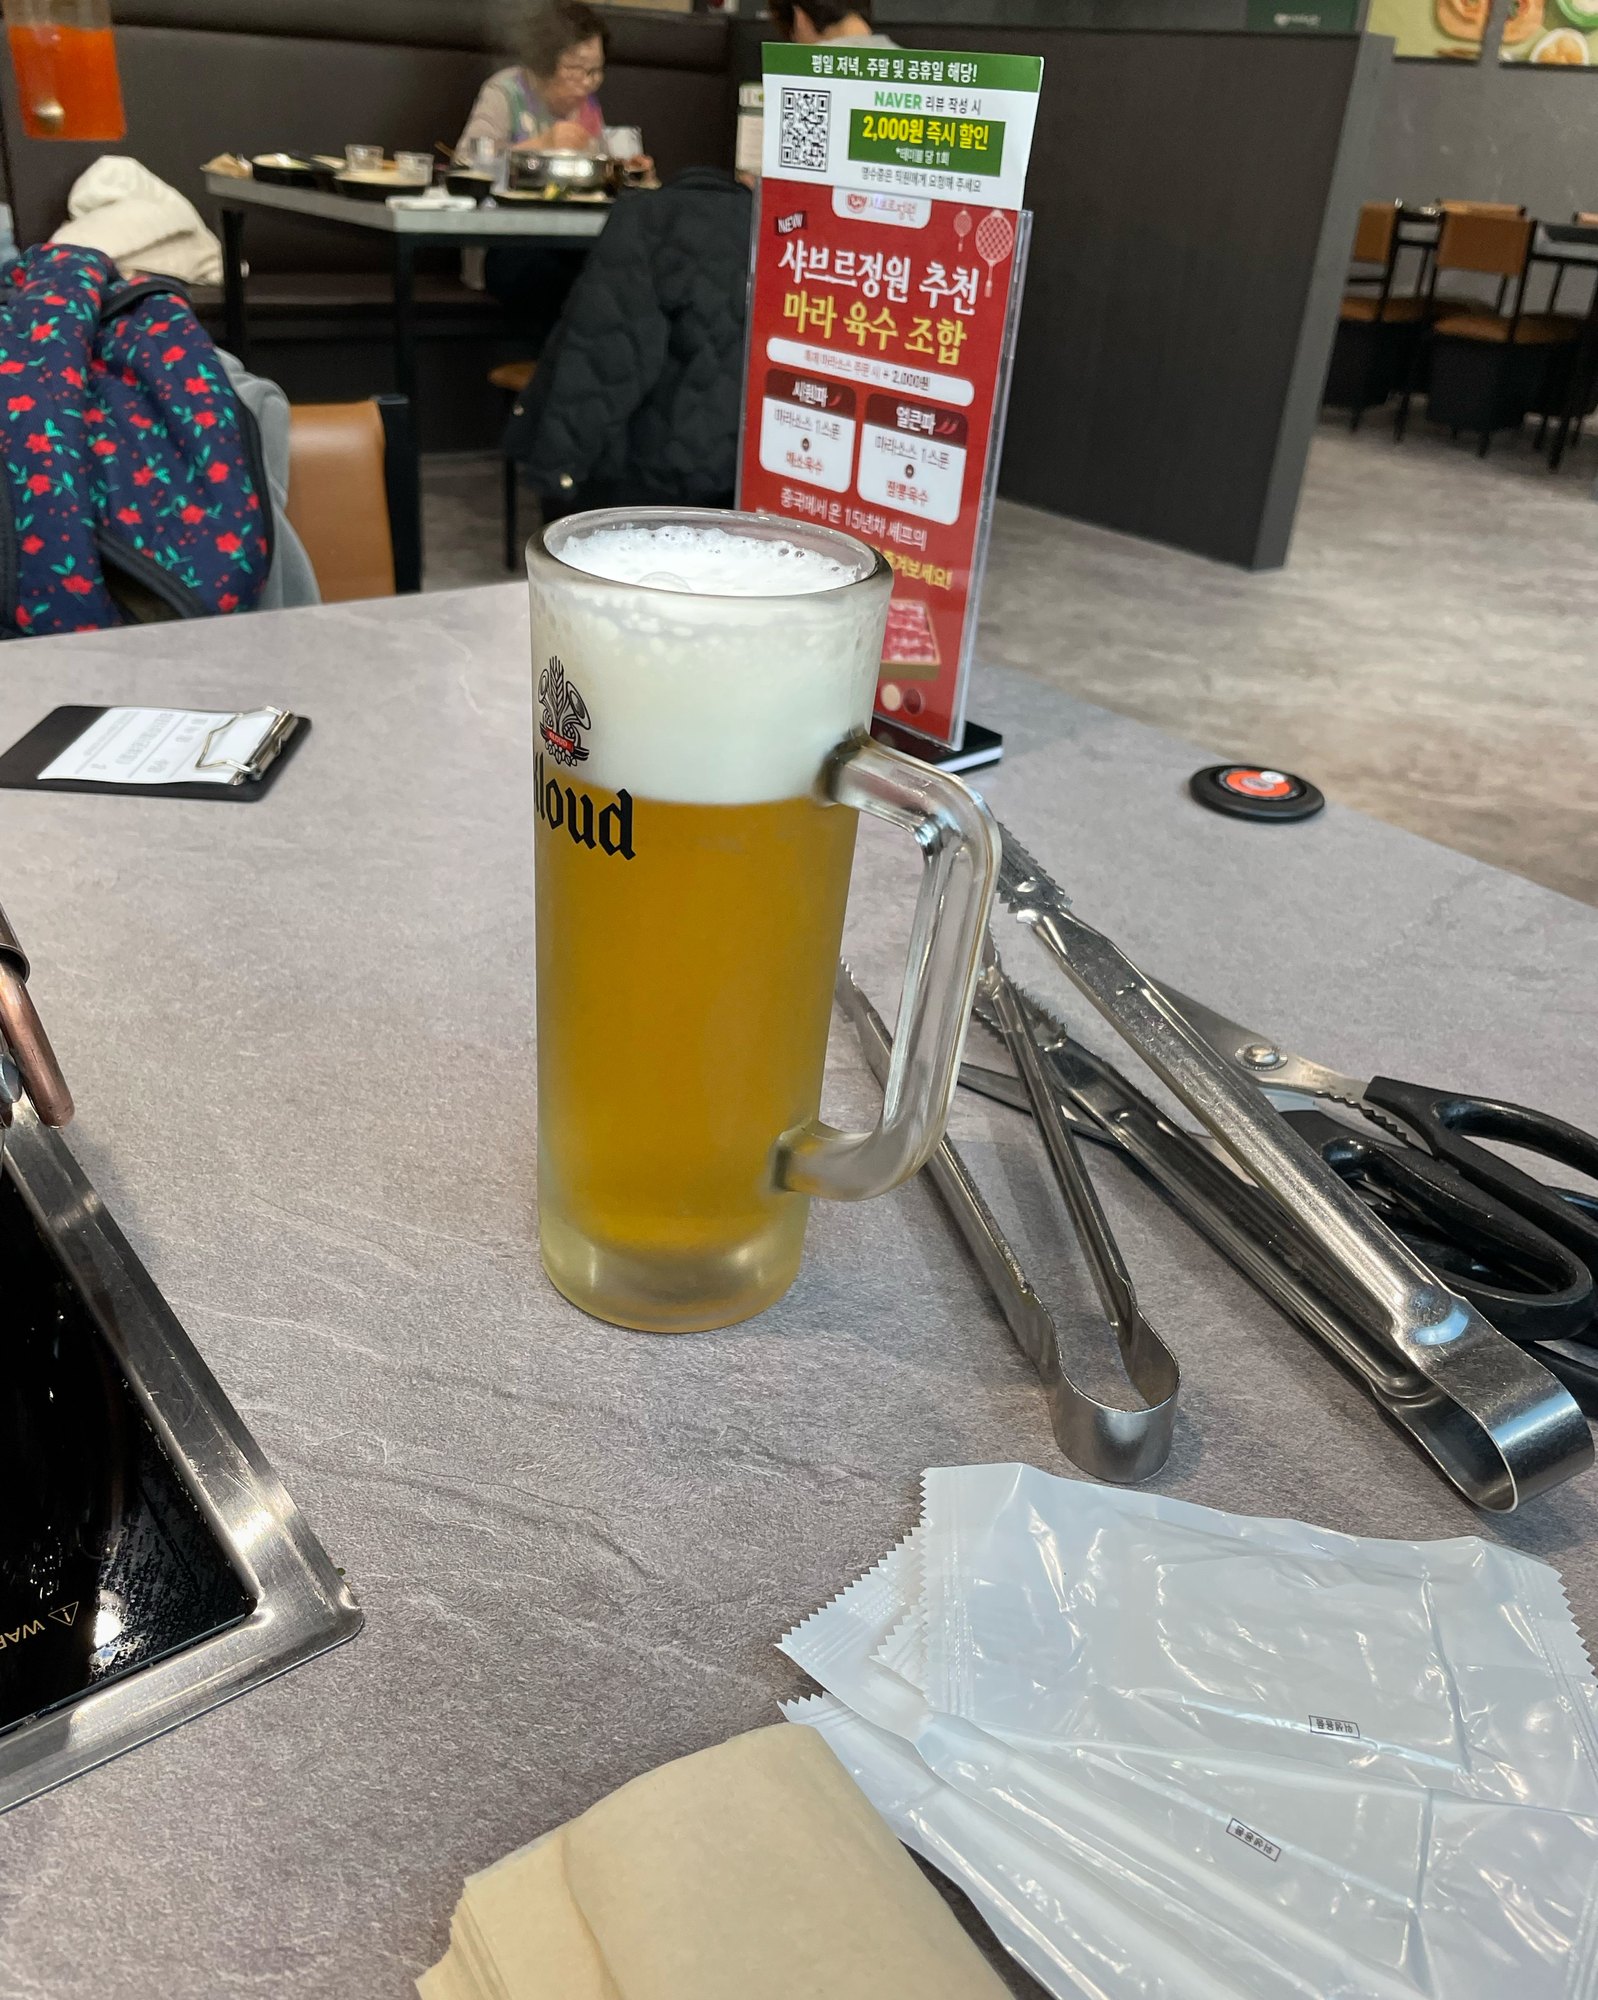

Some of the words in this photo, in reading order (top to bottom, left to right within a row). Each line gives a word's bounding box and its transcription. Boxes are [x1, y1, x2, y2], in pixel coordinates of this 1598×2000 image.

[811, 54, 834, 73] 평일
[837, 57, 863, 77] 저녁,
[867, 58, 890, 78] 주말
[893, 59, 904, 79] 및
[908, 61, 943, 81] 공휴일
[948, 63, 977, 83] 해당!
[874, 91, 922, 110] NAVER
[926, 96, 944, 112] 리뷰
[949, 97, 968, 114] 작성
[971, 99, 981, 116] 시
[862, 115, 923, 145] 2,000원
[926, 121, 955, 148] 즉시
[959, 124, 989, 151] 할인
[778, 213, 803, 233] NEW
[778, 239, 911, 303] 샤브르정원
[919, 261, 979, 315] 추천
[783, 290, 838, 339] 마라
[843, 301, 899, 350] 육수
[904, 317, 967, 365] 조합
[896, 406, 936, 435] 얼큰파
